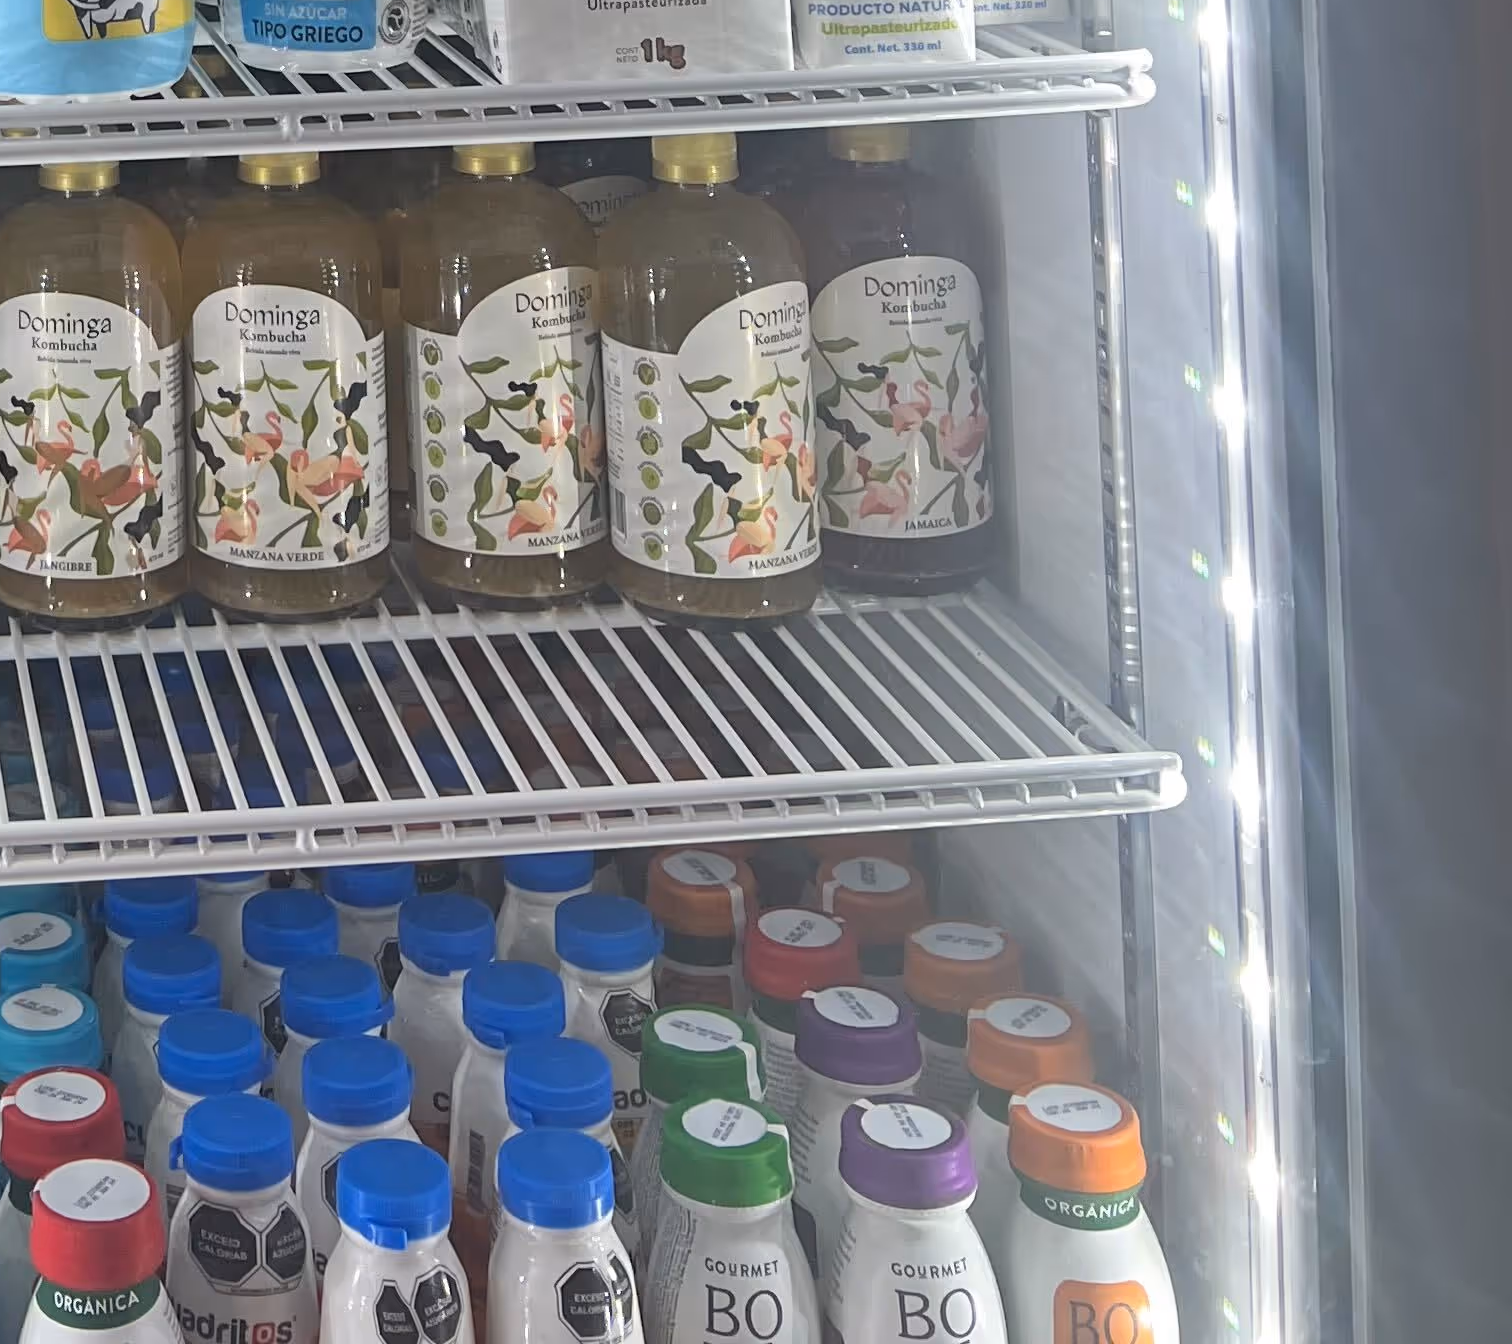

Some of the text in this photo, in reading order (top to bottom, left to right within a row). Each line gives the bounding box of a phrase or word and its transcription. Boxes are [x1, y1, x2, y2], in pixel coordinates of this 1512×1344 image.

[264, 1, 288, 15] SIN
[807, 2, 895, 17] PRODUCTO
[251, 18, 363, 44] TIPO GRIEGO
[863, 273, 957, 298] Dominga
[224, 300, 321, 330] Dominga
[880, 297, 947, 314] Kombucha
[17, 308, 113, 340] Dominga
[531, 309, 586, 330] Kombucha
[31, 336, 98, 352] Kombucha
[239, 328, 307, 344] Kombucha
[753, 326, 803, 347] Kombucha
[904, 516, 953, 533] JAMAICA
[527, 531, 580, 548] MANZANA
[229, 545, 325, 563] MANZANA VERDE
[747, 552, 796, 570] MANZANA
[1044, 1195, 1136, 1220] ORGÁNICA
[704, 1257, 780, 1280] GOURMET
[891, 1257, 968, 1280] GOURMET
[54, 1289, 140, 1316] ORGÁNICA
[704, 1283, 784, 1340] BO
[894, 1287, 977, 1340] BO
